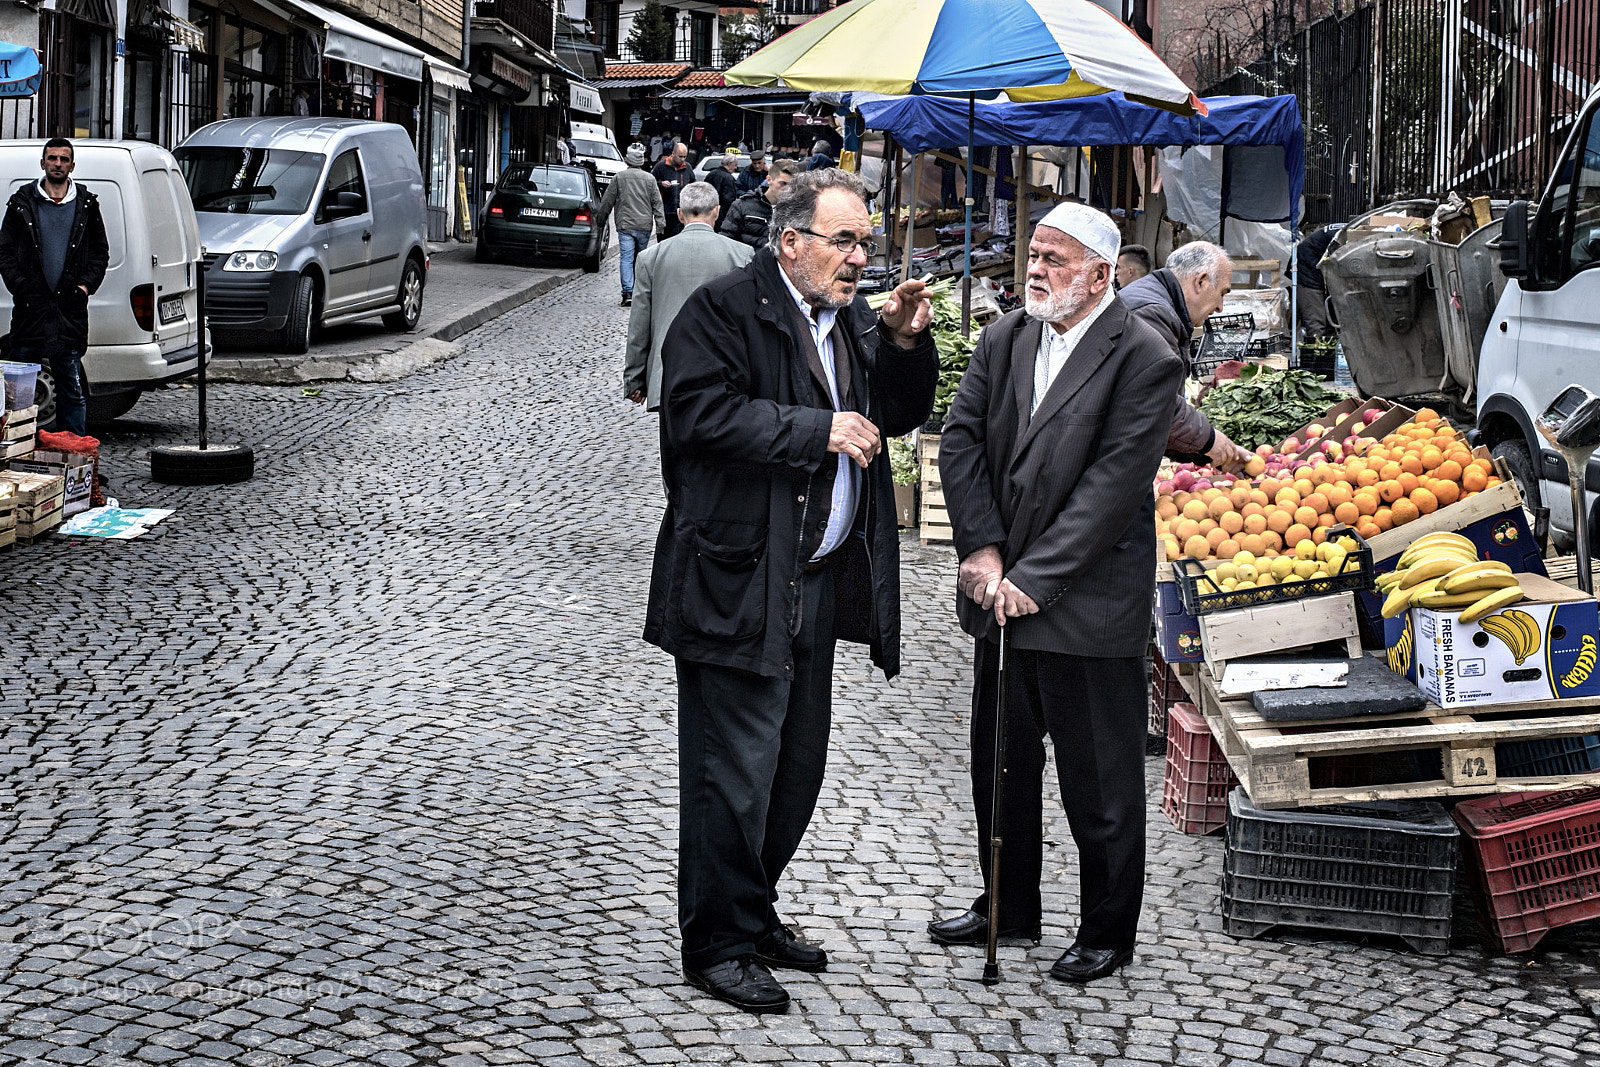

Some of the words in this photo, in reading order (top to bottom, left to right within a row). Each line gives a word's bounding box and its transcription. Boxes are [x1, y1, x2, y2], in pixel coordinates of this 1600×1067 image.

[0, 59, 12, 79] T
[1441, 618, 1453, 652] FRESH
[1561, 634, 1597, 688] EXCELBAN
[1443, 654, 1456, 703] BANANAS
[1461, 756, 1488, 778] 42
